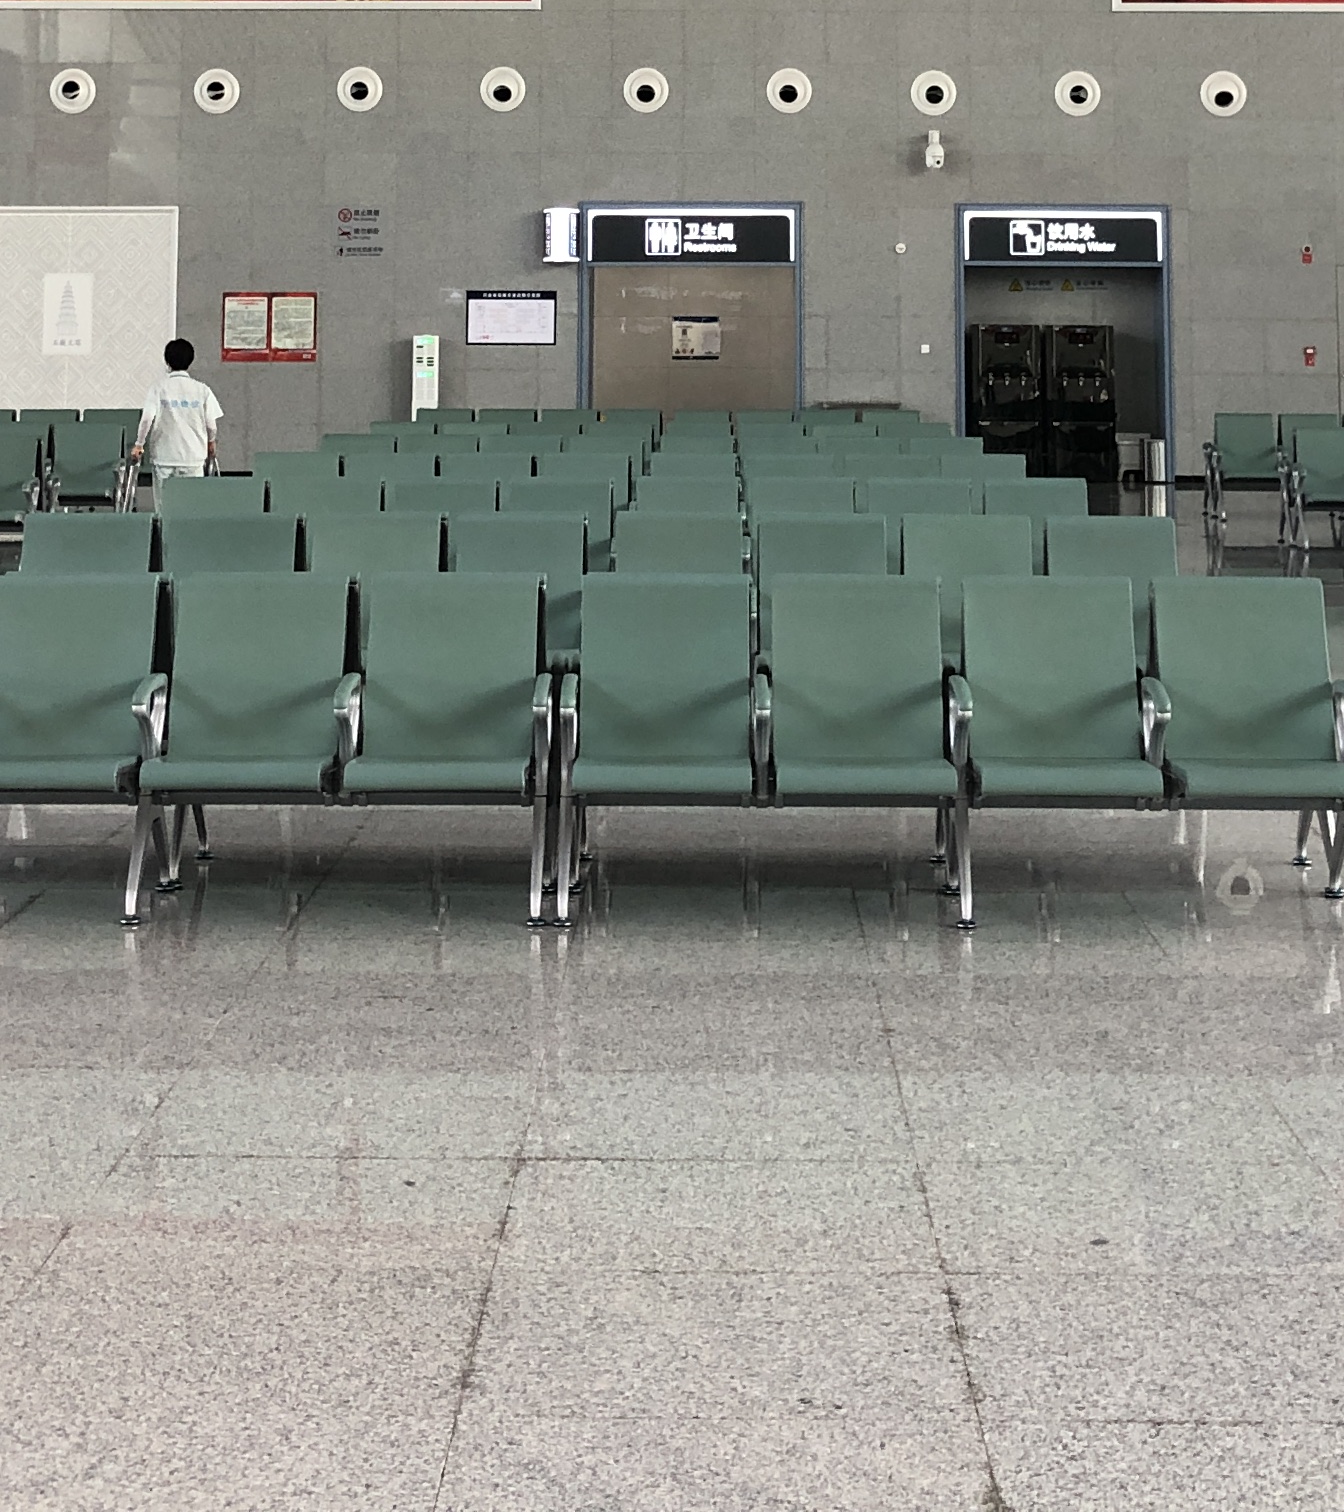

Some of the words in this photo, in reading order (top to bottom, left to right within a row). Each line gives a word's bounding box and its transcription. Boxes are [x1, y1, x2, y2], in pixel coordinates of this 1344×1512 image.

[683, 222, 734, 241] 卫生间
[1047, 222, 1096, 241] 饮用水
